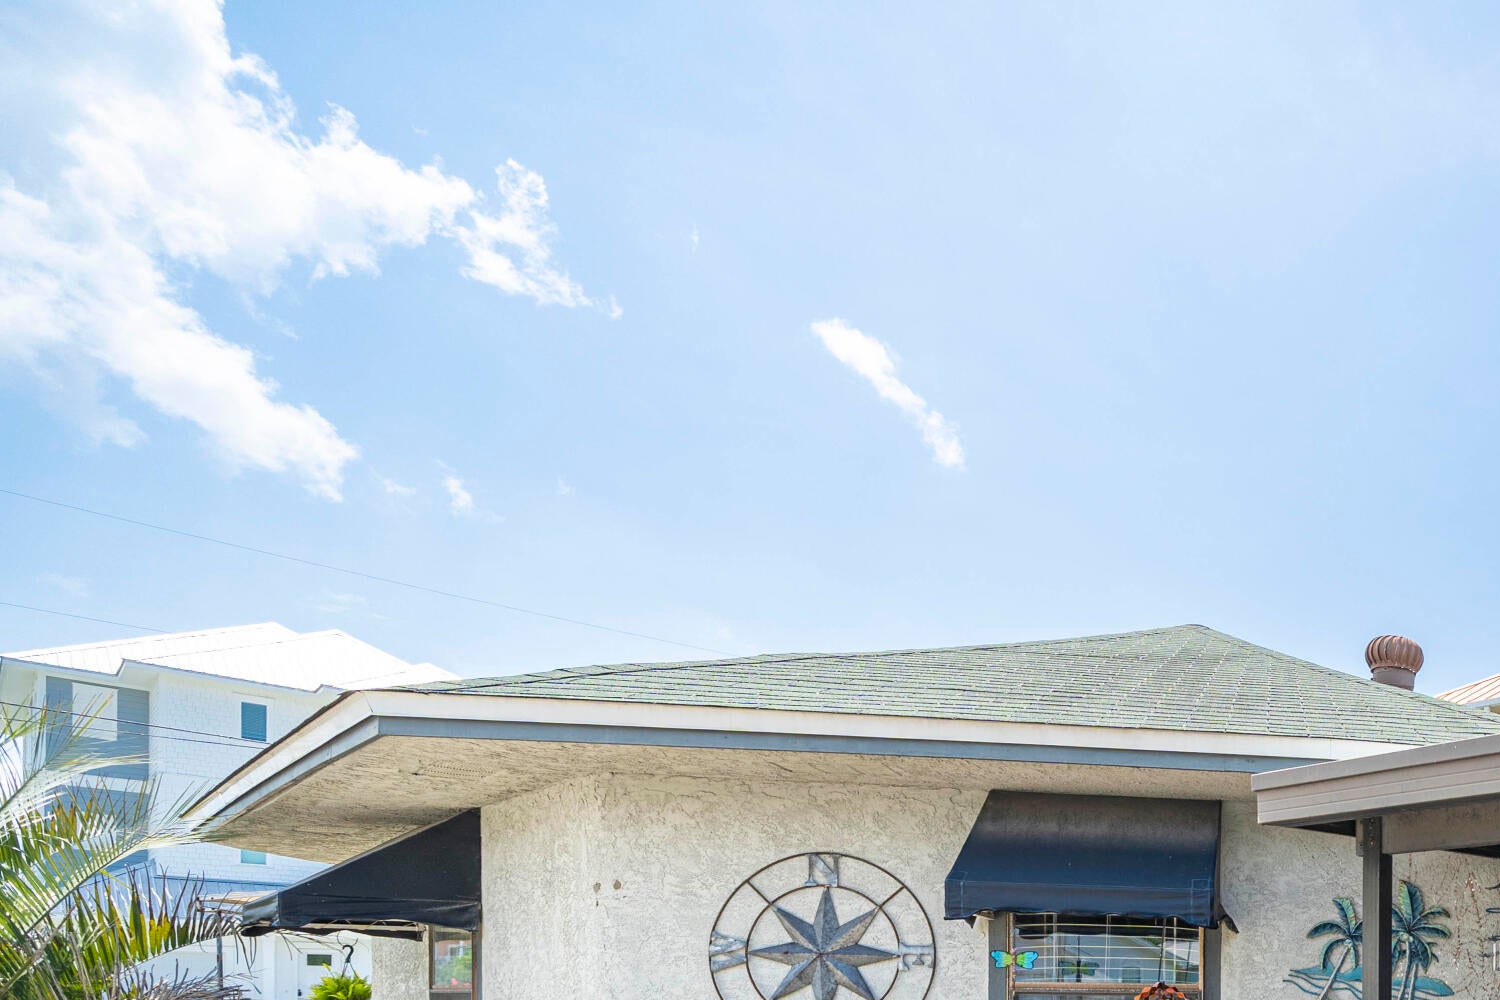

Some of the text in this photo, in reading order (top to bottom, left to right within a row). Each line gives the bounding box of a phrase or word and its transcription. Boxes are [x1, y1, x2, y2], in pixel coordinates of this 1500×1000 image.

[804, 853, 840, 887] N
[709, 930, 747, 973] W
[898, 942, 935, 972] E
